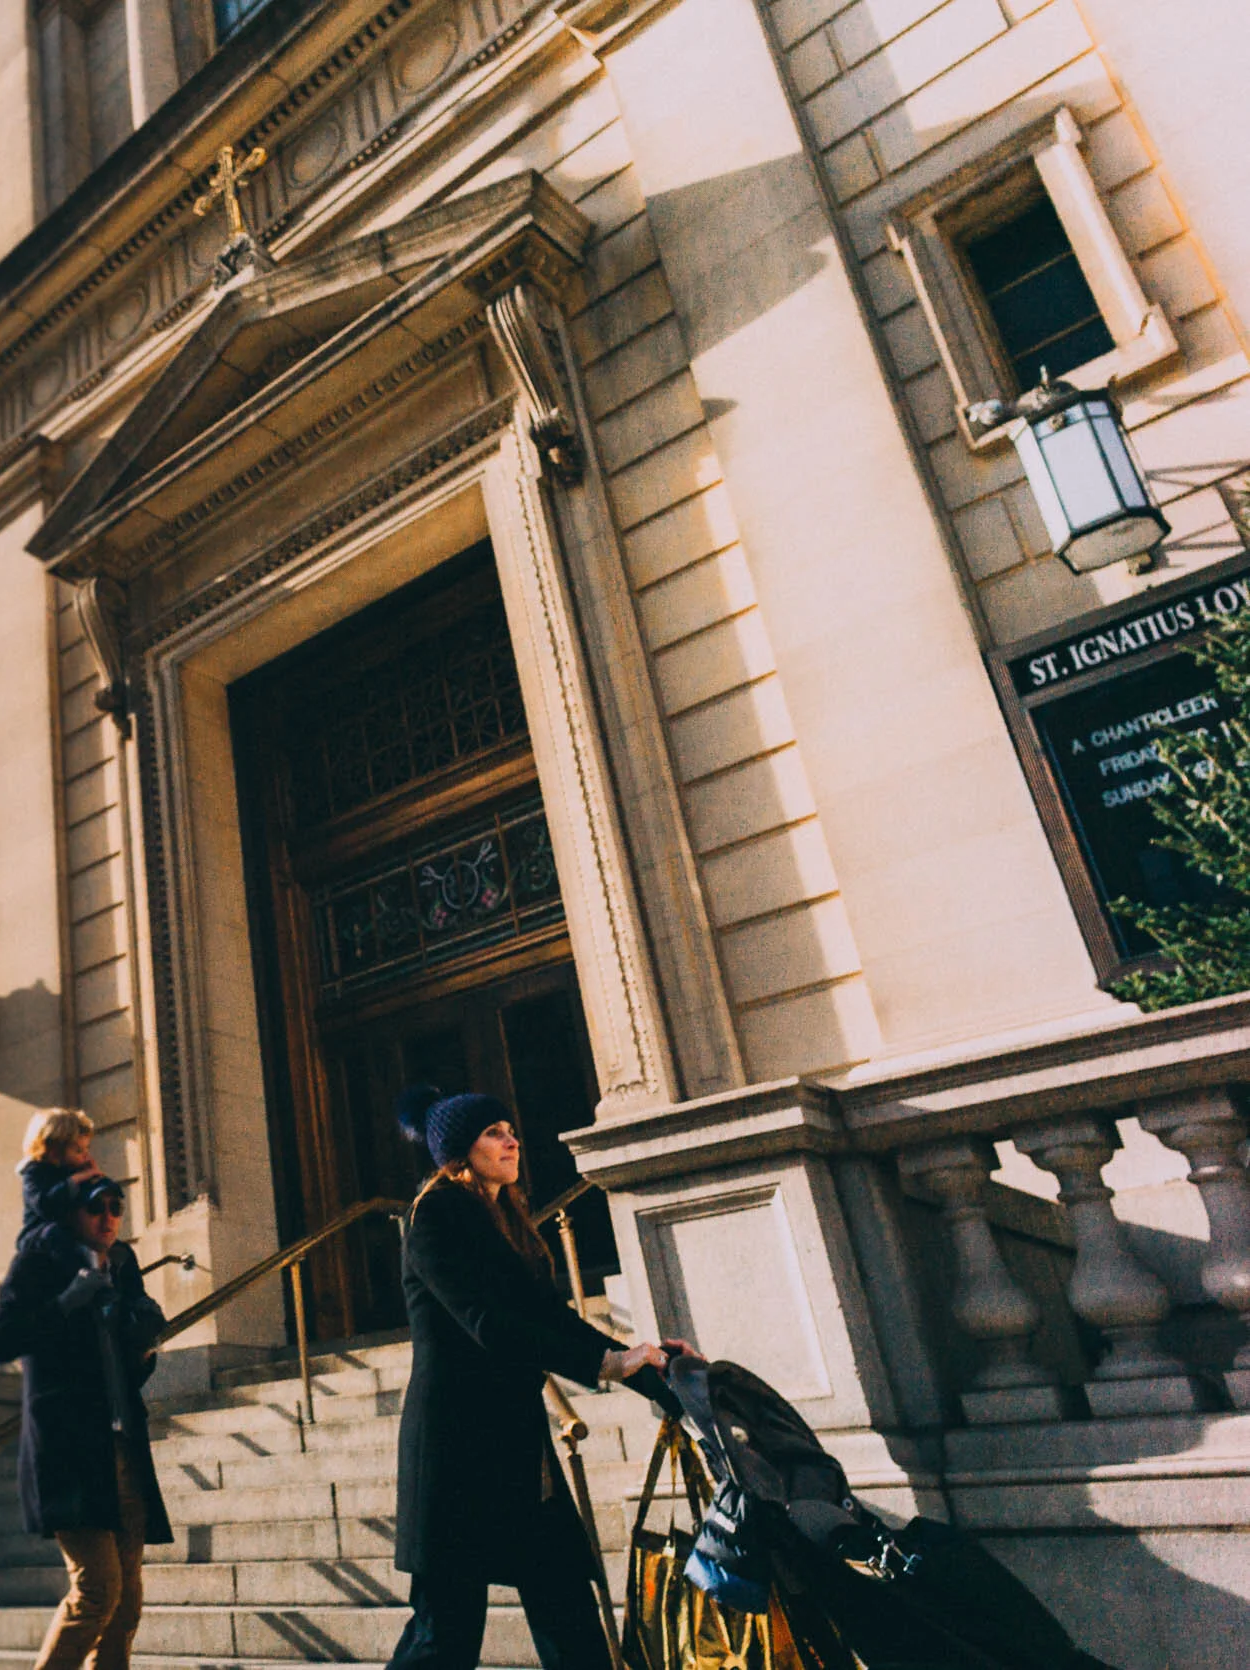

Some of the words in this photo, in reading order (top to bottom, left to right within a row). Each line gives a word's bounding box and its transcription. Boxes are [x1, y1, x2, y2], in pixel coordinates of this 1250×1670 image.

[1028, 653, 1068, 686] ST.
[1069, 602, 1194, 670] IGNATIUS
[1072, 738, 1085, 756] A
[1098, 744, 1159, 776] FRIDAY
[1101, 772, 1170, 808] SUNDAY
